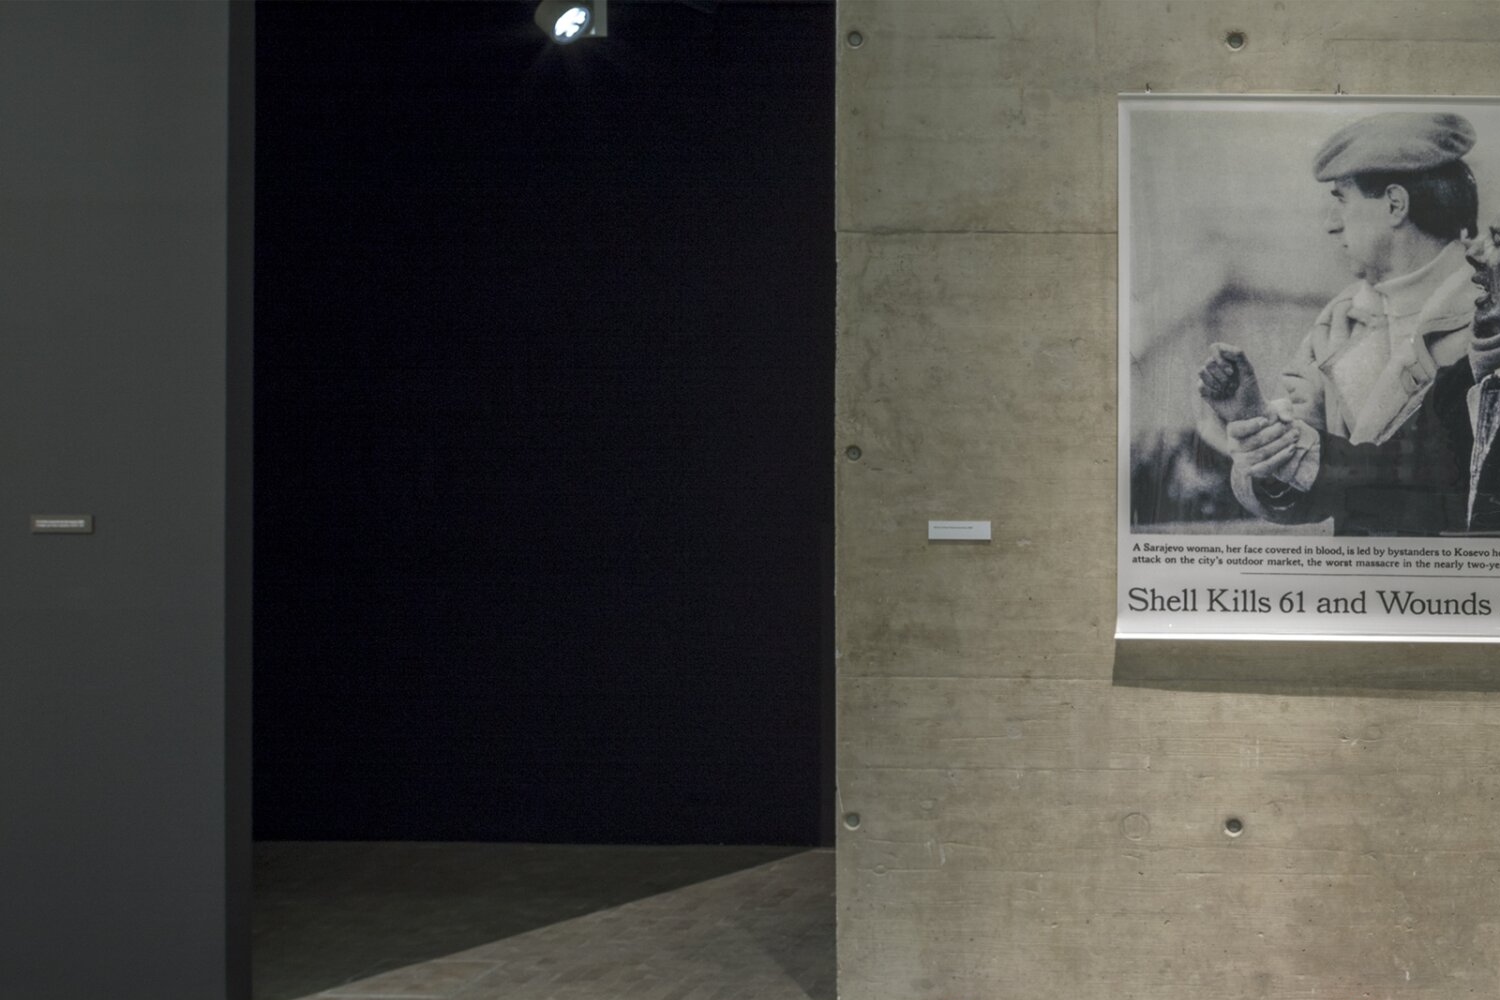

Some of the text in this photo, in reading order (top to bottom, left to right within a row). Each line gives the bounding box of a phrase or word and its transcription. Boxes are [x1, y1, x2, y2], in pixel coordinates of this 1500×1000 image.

[1132, 542, 1142, 552] A
[1143, 542, 1185, 554] Sarajevo
[1186, 546, 1224, 554] woman,
[1225, 544, 1242, 554] her
[1243, 544, 1263, 554] face
[1264, 545, 1302, 555] covered
[1304, 545, 1314, 555] in
[1315, 546, 1345, 556] blood,
[1346, 546, 1355, 555] is
[1356, 546, 1371, 556] led
[1372, 546, 1386, 557] by
[1387, 547, 1440, 558] bystanders
[1441, 549, 1452, 557] to
[1454, 547, 1490, 557] Kosevo
[1131, 554, 1162, 564] attack
[1179, 555, 1196, 564] the
[1197, 555, 1224, 567] city's
[1226, 556, 1264, 566] outdoor
[1267, 557, 1304, 567] market,
[1306, 557, 1323, 567] the
[1325, 559, 1353, 567] worst
[1355, 560, 1400, 568] massacre
[1402, 559, 1412, 568] in
[1415, 559, 1431, 568] the
[1433, 559, 1464, 571] nearly
[1128, 587, 1198, 613] Shell
[1206, 588, 1272, 613] Kills
[1279, 590, 1306, 614] 61
[1316, 590, 1367, 614] and
[1375, 590, 1492, 616] Wounds
